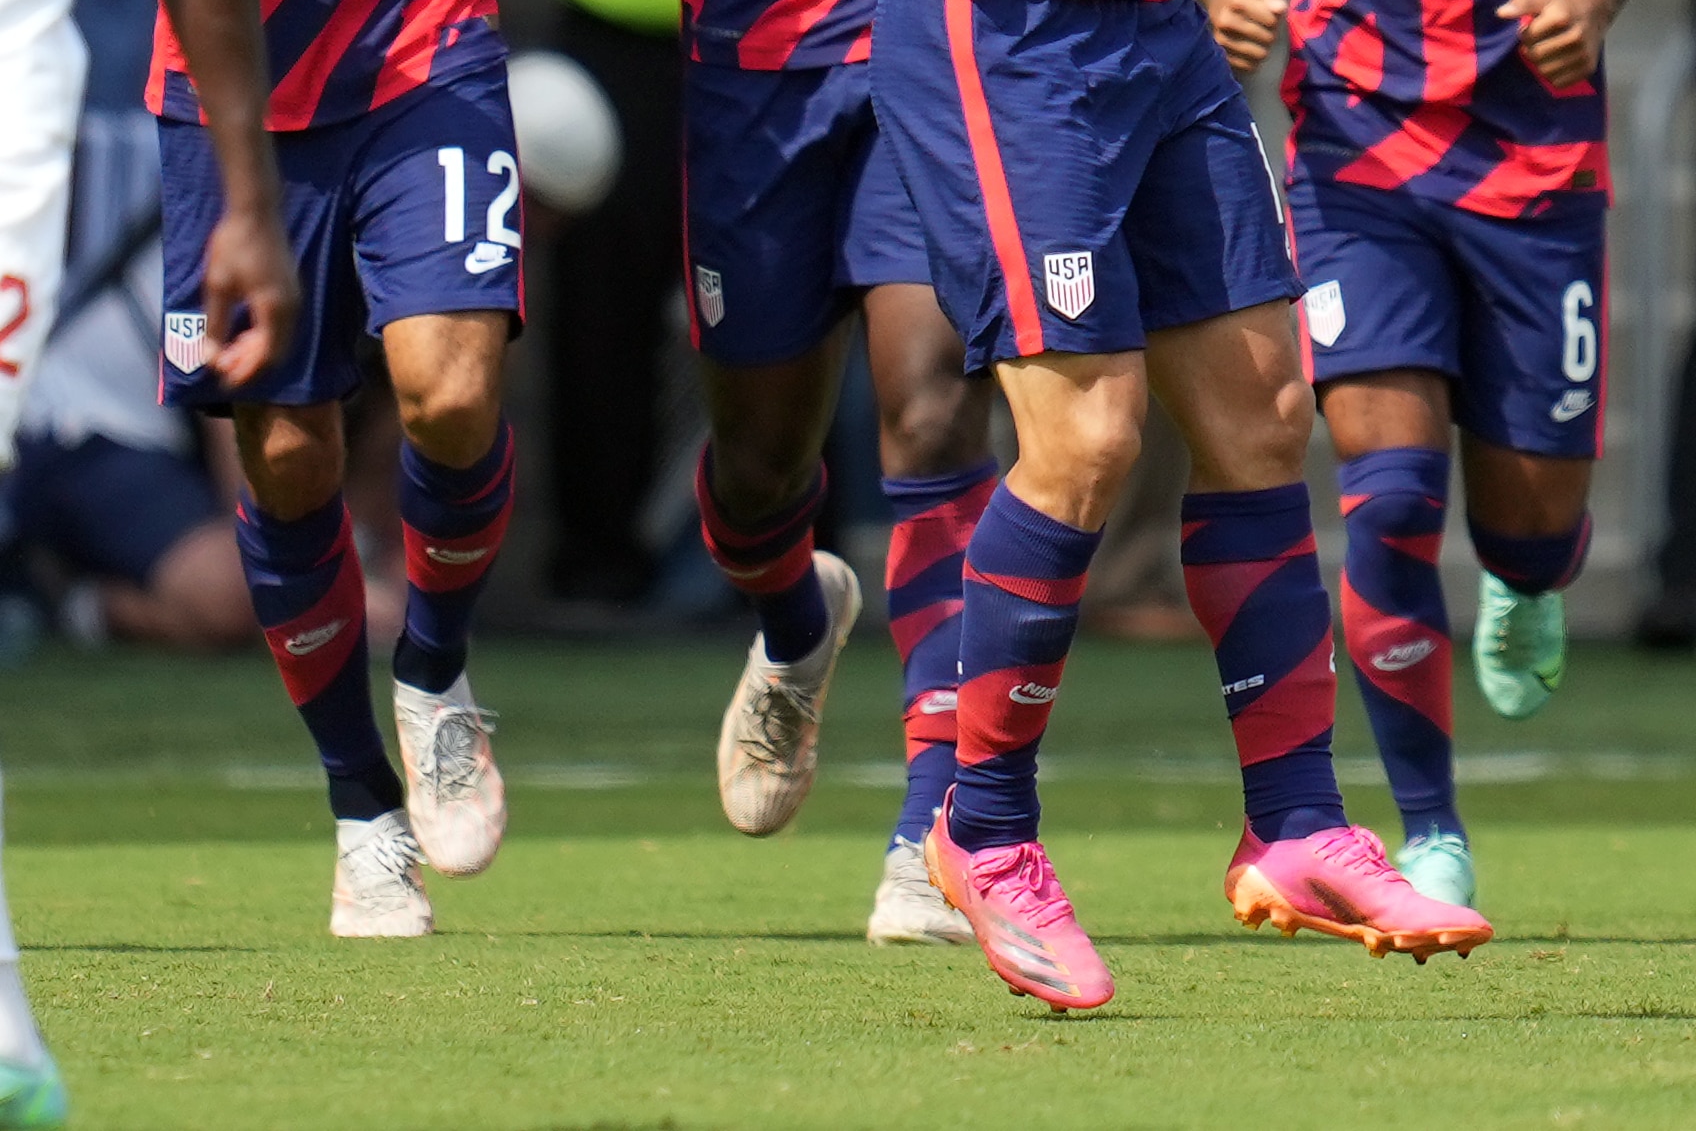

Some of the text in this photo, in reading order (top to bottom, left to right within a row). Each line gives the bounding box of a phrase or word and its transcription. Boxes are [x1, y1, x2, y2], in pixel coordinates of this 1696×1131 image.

[438, 147, 522, 250] 12
[1049, 257, 1088, 280] USA
[169, 317, 205, 338] USA
[1562, 280, 1597, 382] 6
